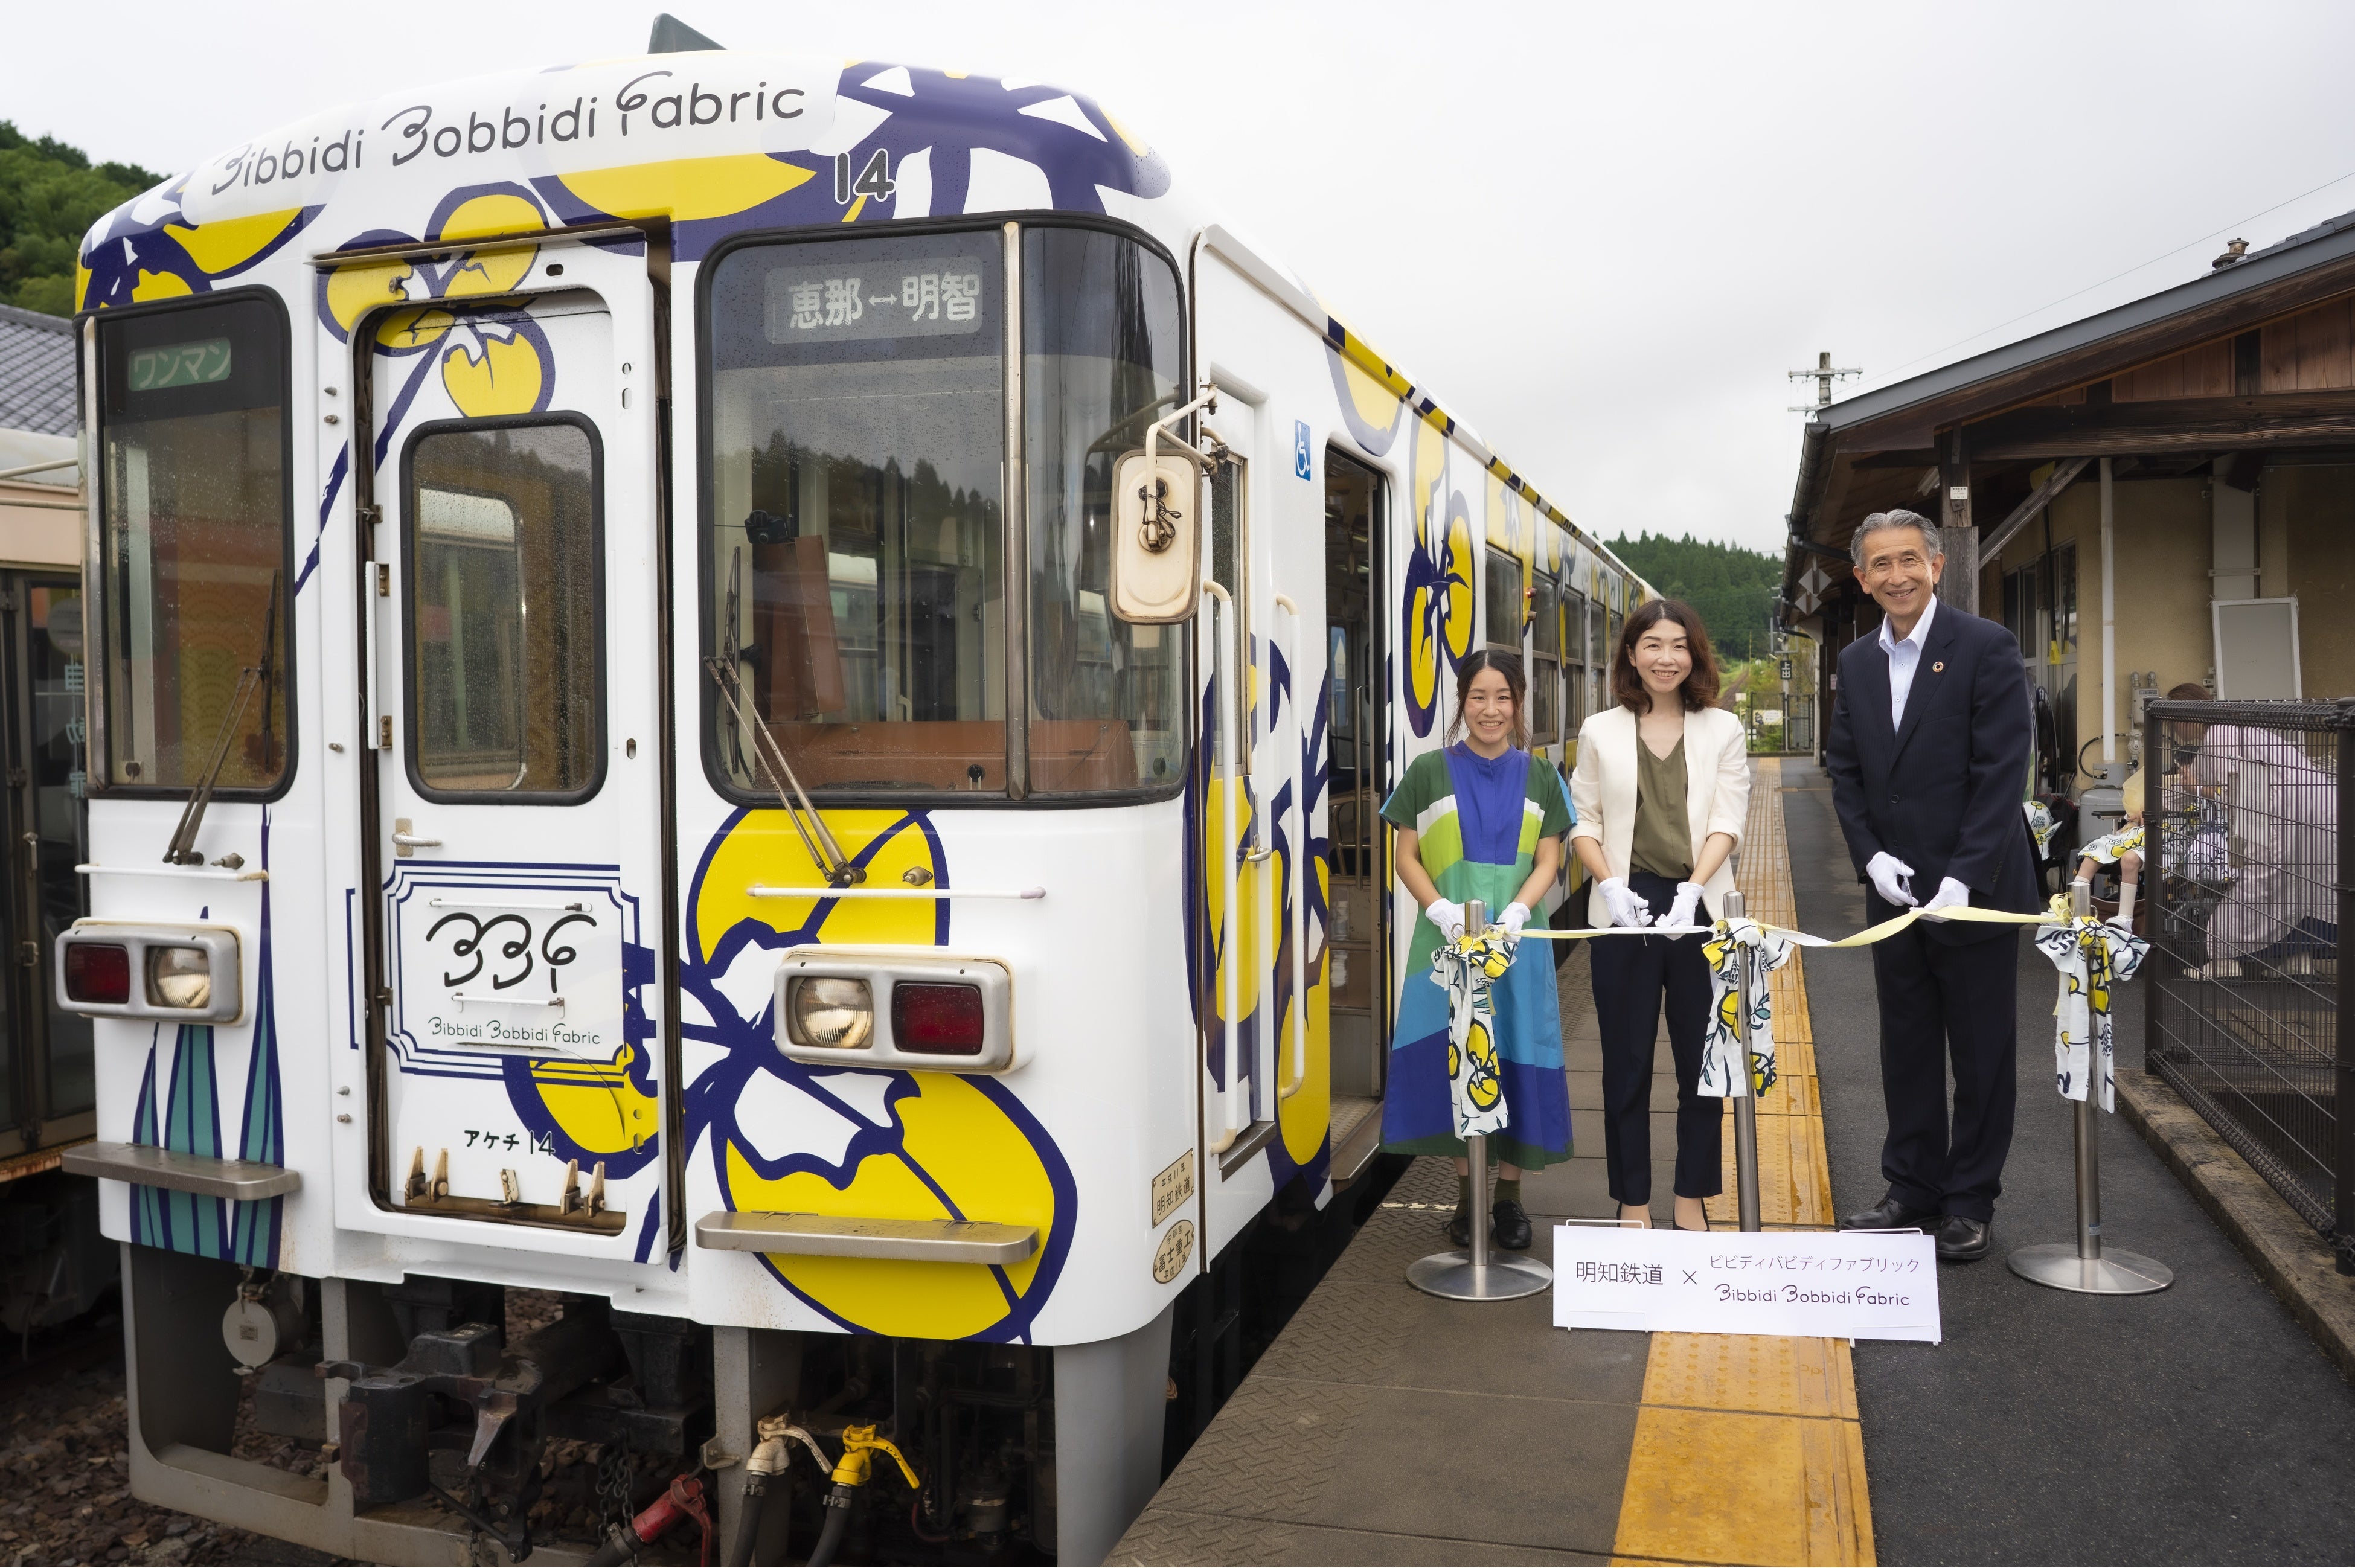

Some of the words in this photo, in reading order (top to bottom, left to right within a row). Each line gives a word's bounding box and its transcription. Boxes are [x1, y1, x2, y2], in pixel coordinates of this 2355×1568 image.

[212, 129, 364, 196] Bibbidi
[382, 97, 598, 167] Bobbidi
[615, 71, 804, 136] Fabric
[835, 149, 896, 205] 14
[788, 277, 863, 331] 恵那
[901, 272, 981, 324] 明智
[133, 344, 232, 389] ワンマン
[428, 1017, 482, 1037] Bibbidi
[486, 1020, 548, 1042] Bobbidi
[552, 1023, 600, 1045] Fabric
[464, 1130, 519, 1151] アケチ
[530, 1131, 555, 1156] 14
[1156, 1174, 1190, 1216] 明知鉄道
[1158, 1230, 1191, 1273] 富士重工
[1710, 1255, 1920, 1273] ビビディバビディファブリック
[1576, 1261, 1664, 1285] 明知鉄道
[1714, 1284, 1777, 1302] Bibbidi
[1781, 1284, 1851, 1304] Bobbidi
[1855, 1285, 1909, 1305] Fabric
